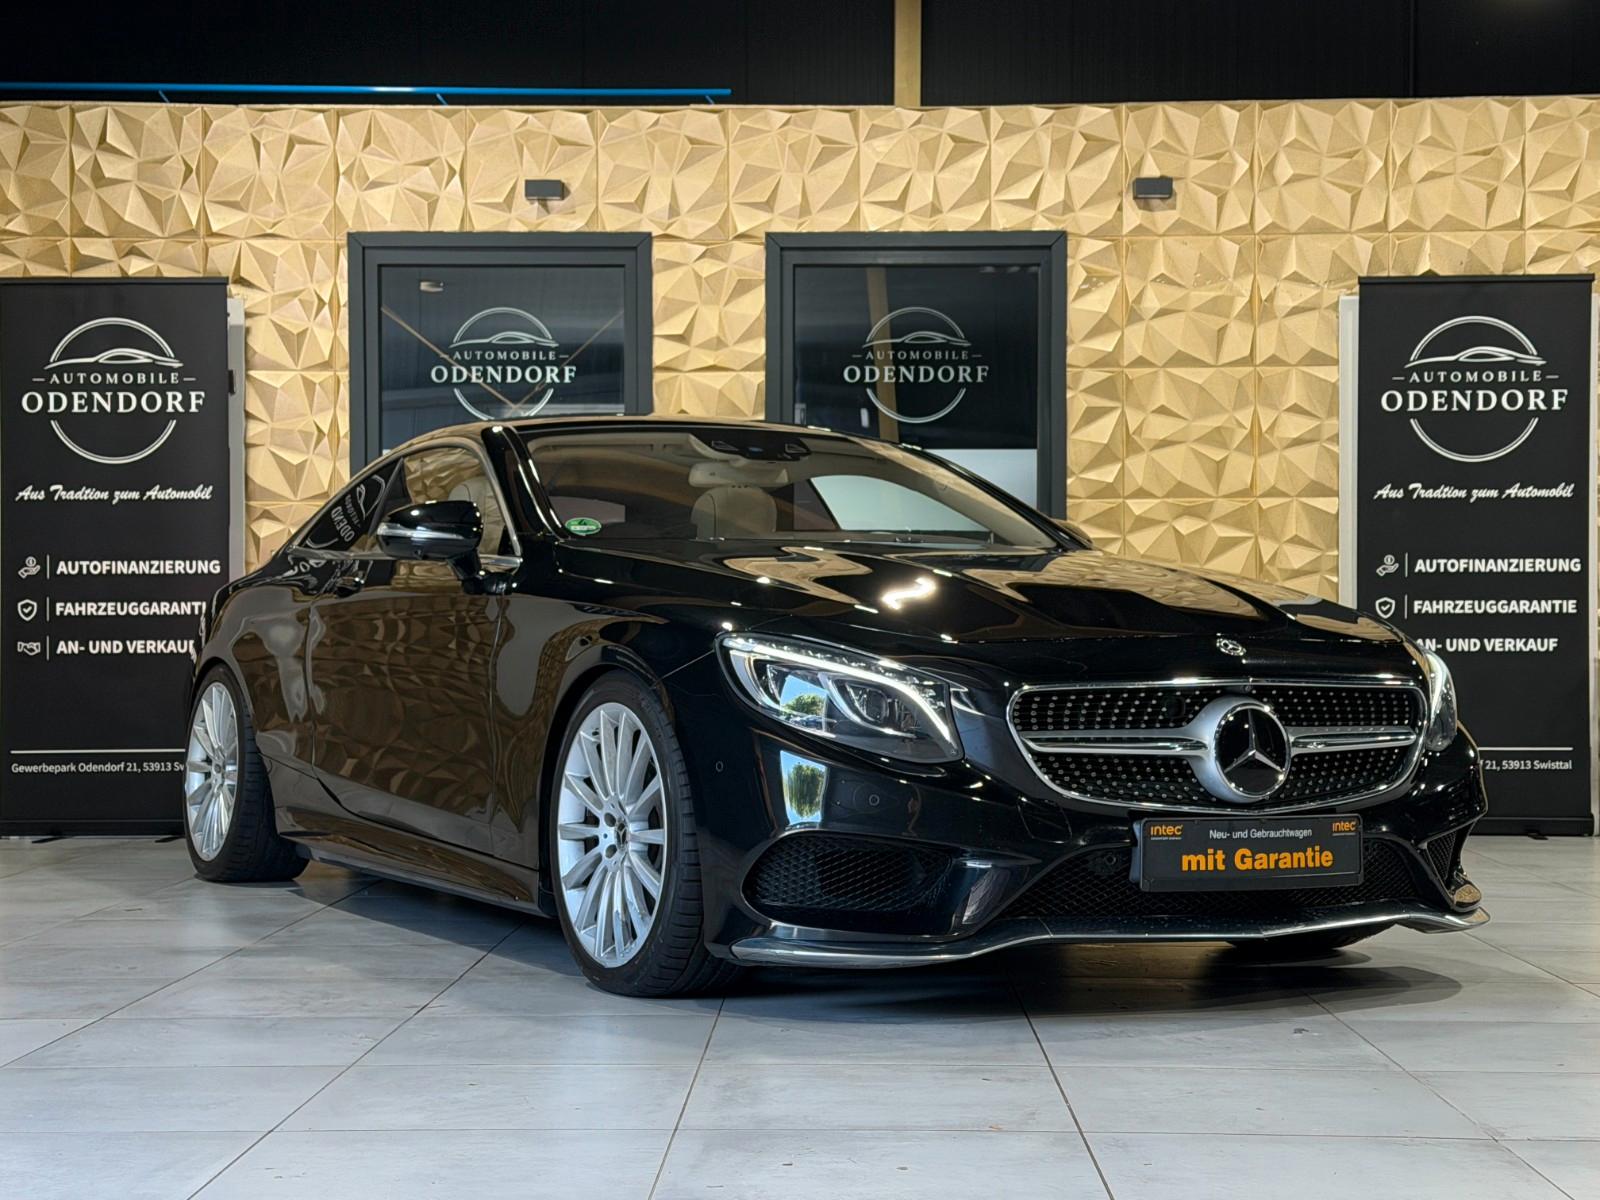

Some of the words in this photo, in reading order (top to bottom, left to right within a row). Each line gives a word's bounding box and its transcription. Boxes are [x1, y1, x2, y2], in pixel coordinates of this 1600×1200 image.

[453, 351, 556, 360] AUTOMOBILE
[866, 351, 969, 360] AUTOMOBILE
[50, 372, 180, 385] AUTOMOBILE
[431, 365, 577, 384] ODENDORF
[843, 365, 990, 383] ODENDORF
[1409, 370, 1542, 383] AUTOMOBILE
[21, 391, 206, 414] ODENDORF
[1380, 389, 1569, 412] ODENDORF
[15, 485, 45, 502] Aus
[112, 490, 141, 505] zum
[143, 484, 213, 501] Automobil
[1373, 483, 1404, 500] Aus
[1470, 489, 1499, 503] zum
[1501, 482, 1575, 499] Automobil
[56, 560, 221, 575] AUTOFINANZIERUNG
[1414, 558, 1582, 573] AUTOFINANZIERUNG
[55, 601, 206, 616] FAHRZEUGGARANTI
[1413, 600, 1578, 614] FAHRZEUGGARANTIE
[56, 640, 85, 655] AN-
[89, 640, 123, 654] UND
[1446, 638, 1480, 652] UND
[1484, 638, 1558, 652] VERKAUF
[11, 762, 77, 774] Gewerbepark
[78, 761, 125, 773] Odendorf
[126, 761, 141, 774] 21,
[143, 761, 172, 772] 53913
[1485, 760, 1500, 771] 21,
[1502, 760, 1531, 770] 53913
[1533, 760, 1572, 770] Swisttal
[1209, 829, 1231, 839] Neu-
[1232, 829, 1249, 839] und
[1250, 828, 1312, 840] Gebrauchtwagen
[1181, 848, 1226, 871] mit
[1234, 845, 1334, 870] Garantie
